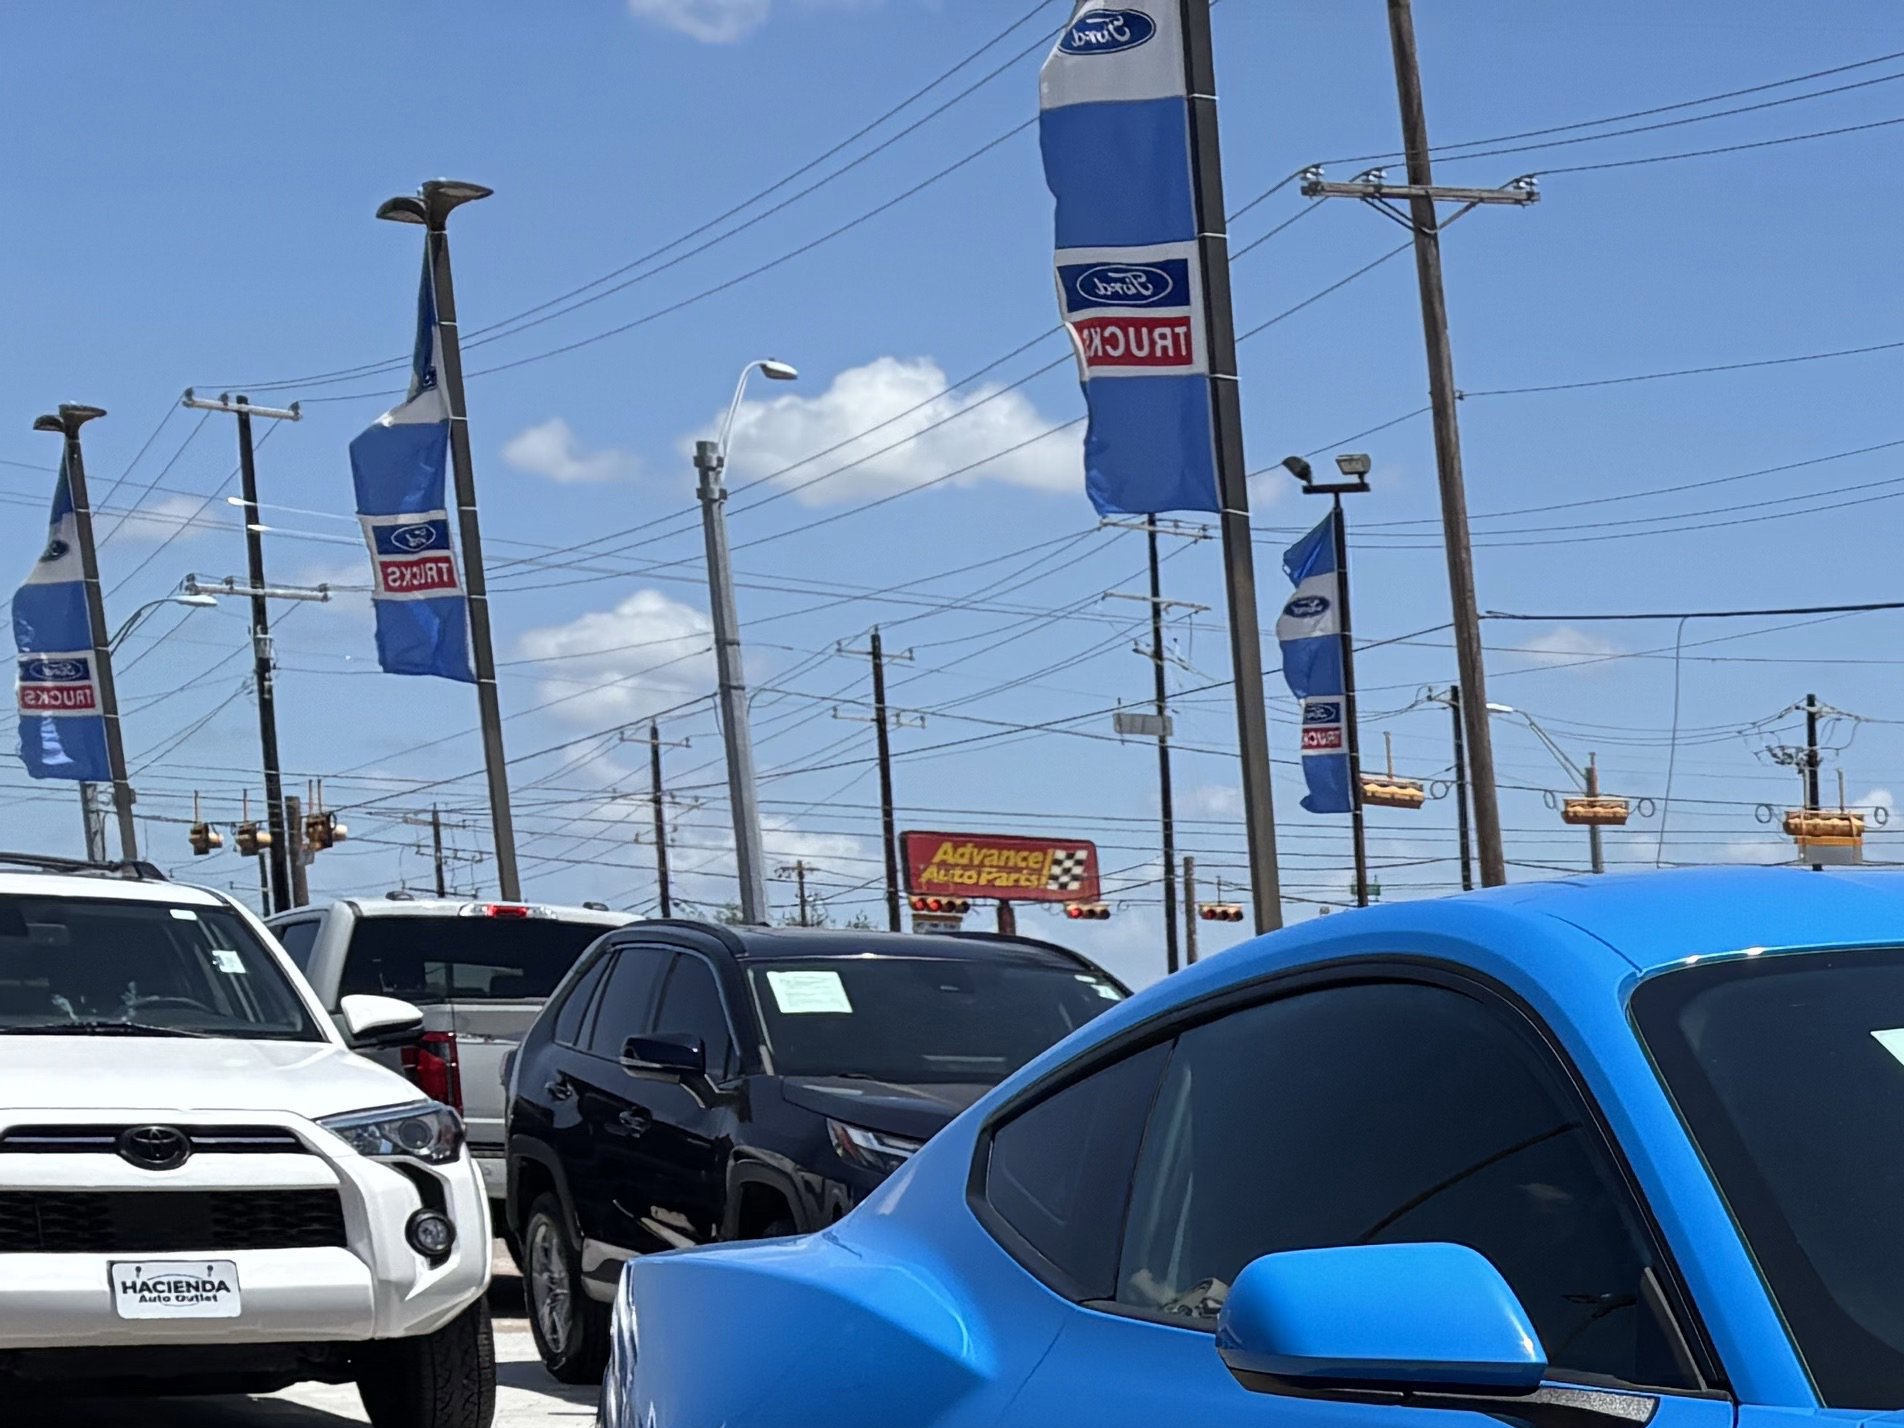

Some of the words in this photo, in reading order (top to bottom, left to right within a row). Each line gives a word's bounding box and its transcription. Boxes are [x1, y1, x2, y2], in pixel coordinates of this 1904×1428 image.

[931, 841, 1045, 868] Advance
[919, 864, 977, 885] Auto
[978, 867, 1039, 887] Parts
[121, 1280, 231, 1295] HACIENDA
[139, 1294, 170, 1303] Auto
[175, 1293, 218, 1303] Outlet
